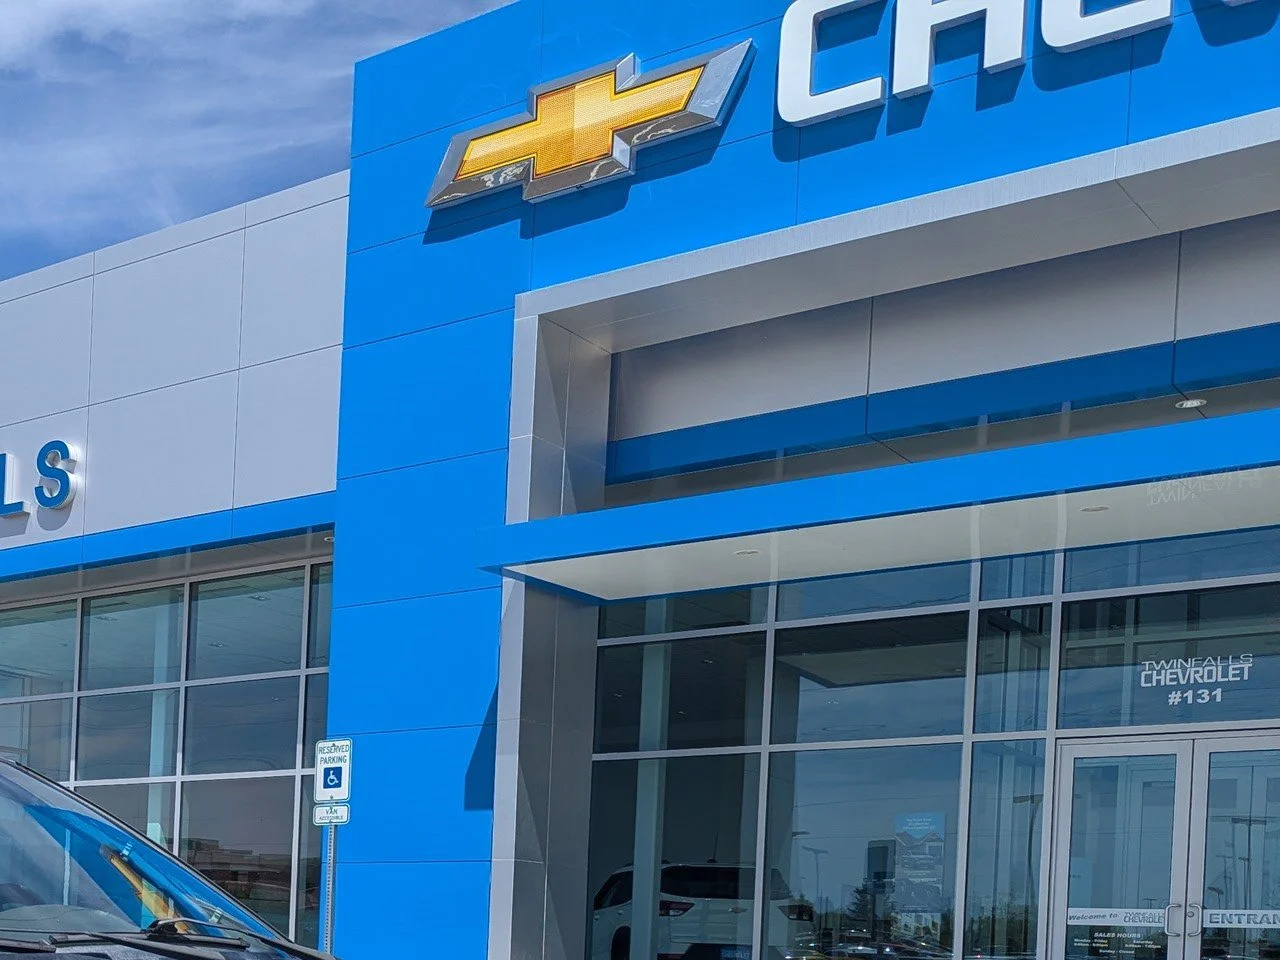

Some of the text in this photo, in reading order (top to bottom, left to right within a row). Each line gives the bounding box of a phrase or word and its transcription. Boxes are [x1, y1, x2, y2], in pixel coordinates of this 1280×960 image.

[1140, 663, 1253, 688] CHEVROLET
[1167, 687, 1223, 706] #131
[318, 744, 350, 755] RESERVED
[319, 755, 347, 765] PARKING
[1068, 913, 1107, 921] Welcome
